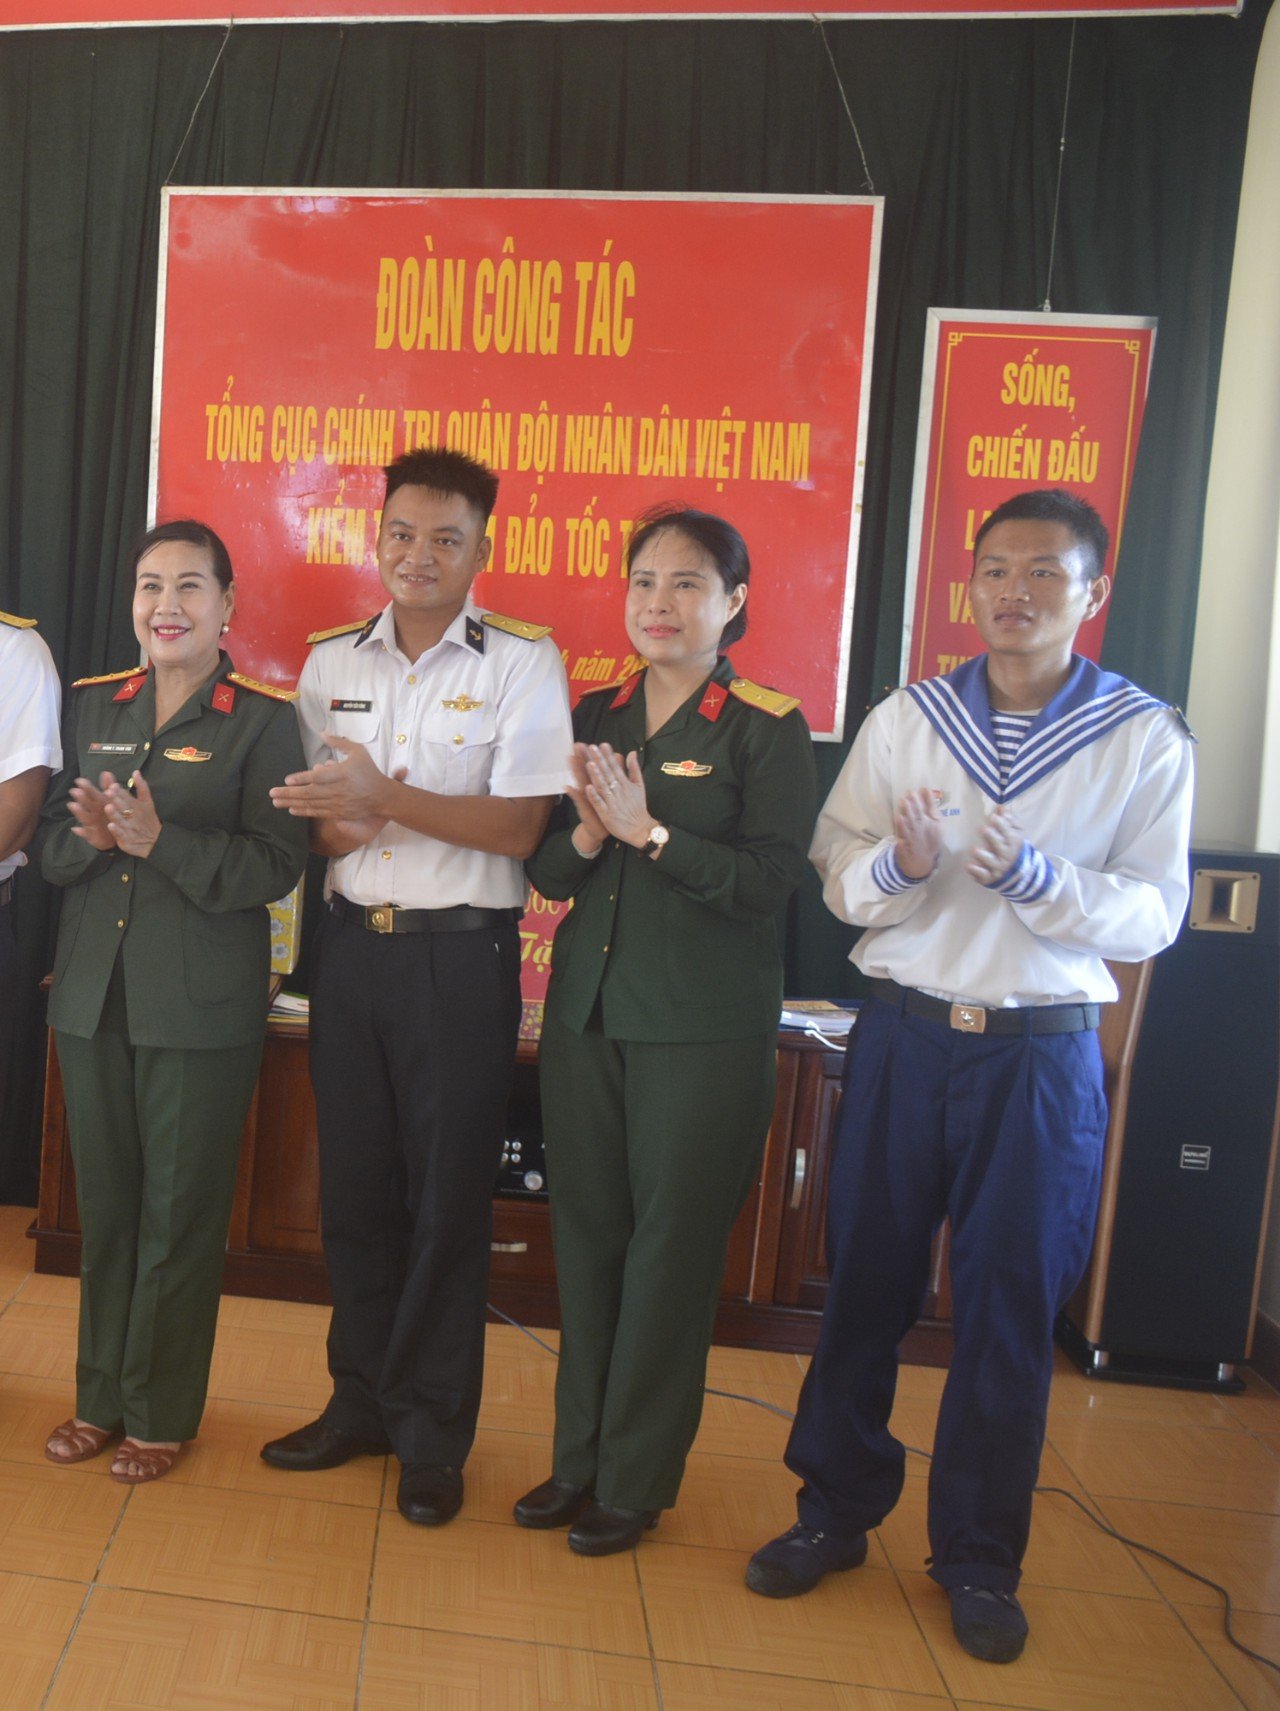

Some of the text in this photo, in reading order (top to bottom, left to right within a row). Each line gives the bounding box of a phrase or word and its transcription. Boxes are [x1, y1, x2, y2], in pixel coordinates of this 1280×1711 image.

[375, 234, 636, 358] ĐOÀN CÔNG TÁC
[1000, 347, 1076, 413] SỐNG,
[205, 375, 266, 464] TỔNG
[270, 403, 319, 476] CỤC
[322, 393, 396, 467] CHÍNH
[516, 400, 559, 485] ĐỘI
[563, 402, 633, 475] NHÂN
[636, 403, 690, 478] DÂN
[694, 405, 747, 493] VIỆT
[750, 420, 811, 482] NAM
[966, 423, 1101, 484] CHIẾN ĐẤU
[305, 479, 367, 566] KIỂM
[504, 493, 554, 577] ĐẢO
[565, 496, 611, 578] TỐC
[569, 648, 616, 681] năm
